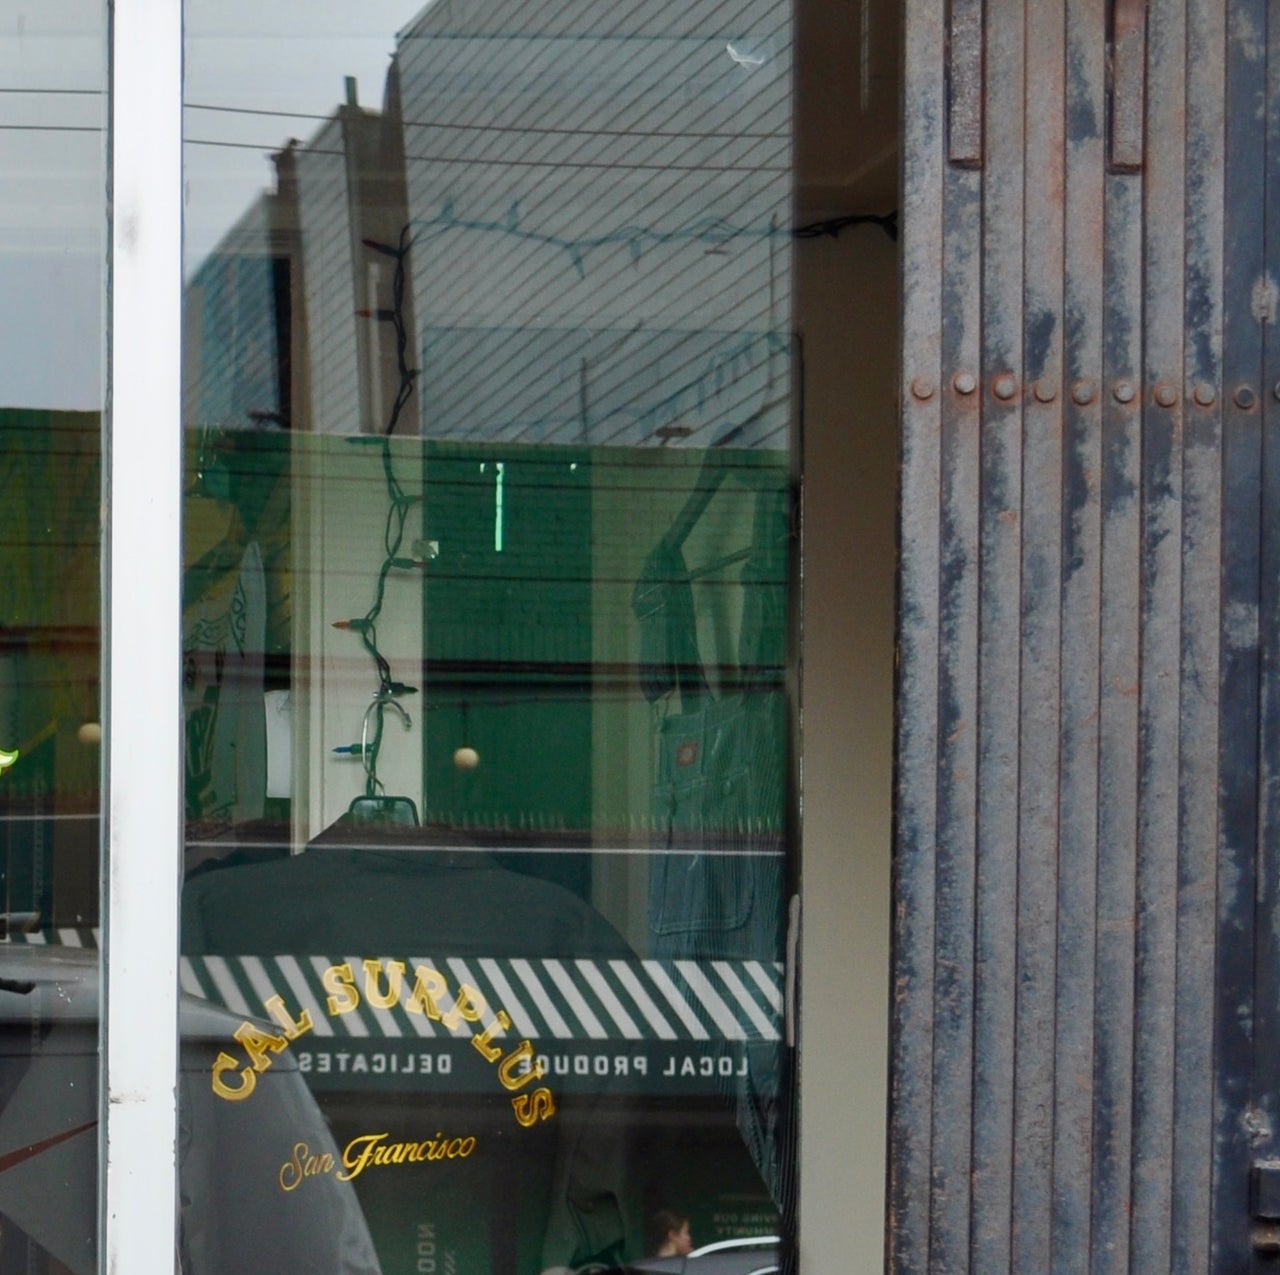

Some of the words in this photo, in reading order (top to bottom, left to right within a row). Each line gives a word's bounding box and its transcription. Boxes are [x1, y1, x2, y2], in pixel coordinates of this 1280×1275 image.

[210, 994, 315, 1101] CAL
[321, 958, 556, 1128] SURPLUS
[278, 1141, 334, 1191] San
[335, 1130, 477, 1182] Francisco
